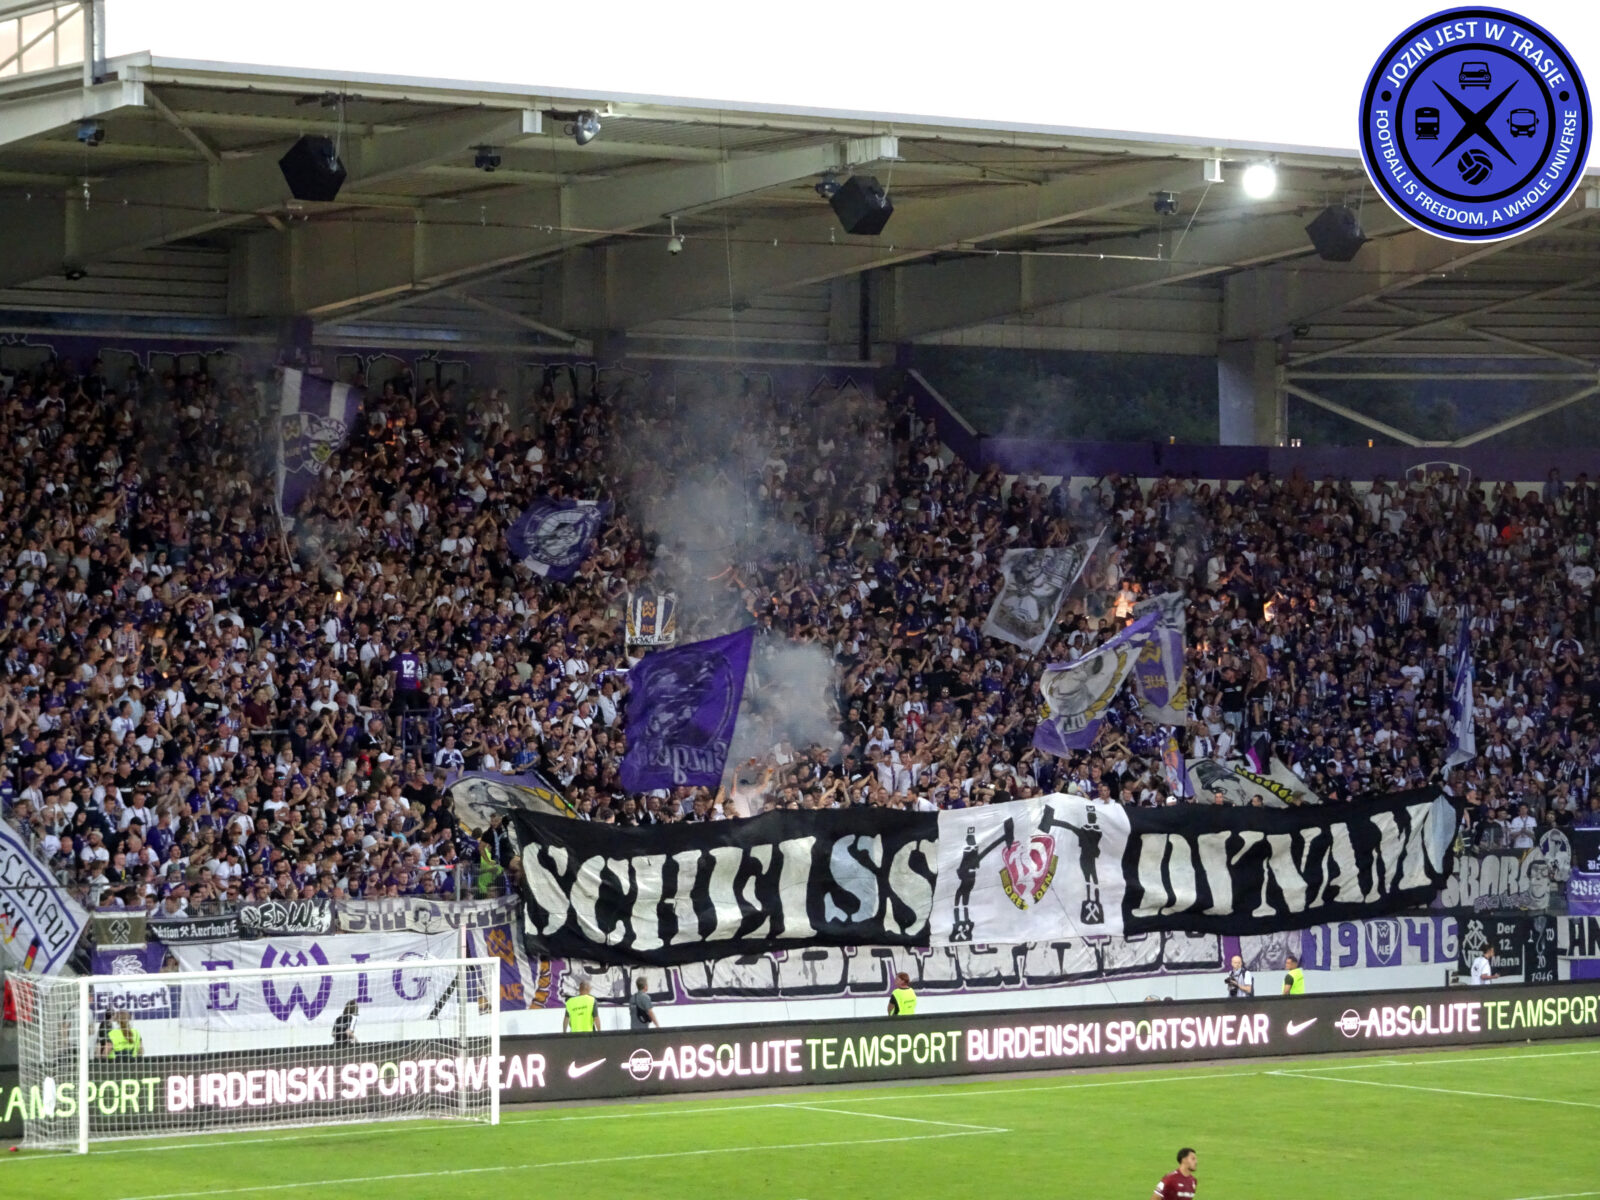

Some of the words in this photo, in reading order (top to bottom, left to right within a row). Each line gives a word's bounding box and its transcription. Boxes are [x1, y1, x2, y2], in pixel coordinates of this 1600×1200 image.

[402, 660, 415, 674] 12
[522, 834, 938, 951] SCHEISS
[1497, 922, 1516, 934] Der
[1498, 938, 1513, 951] 12.
[200, 942, 431, 1022] EWIG
[1364, 1002, 1482, 1037] ABSOLUTE
[1483, 995, 1600, 1030] TEAMSPOR
[658, 1039, 803, 1081] ABSOLUTE
[806, 1030, 962, 1071] TEAMSPORT
[967, 1022, 1100, 1062] BURDENSKI
[1104, 1013, 1270, 1053] SPORTSWEAR
[0, 1076, 161, 1122] AMSPORT
[167, 1064, 334, 1112] BURDENSKI
[341, 1053, 546, 1100] SPORTSWEAR
